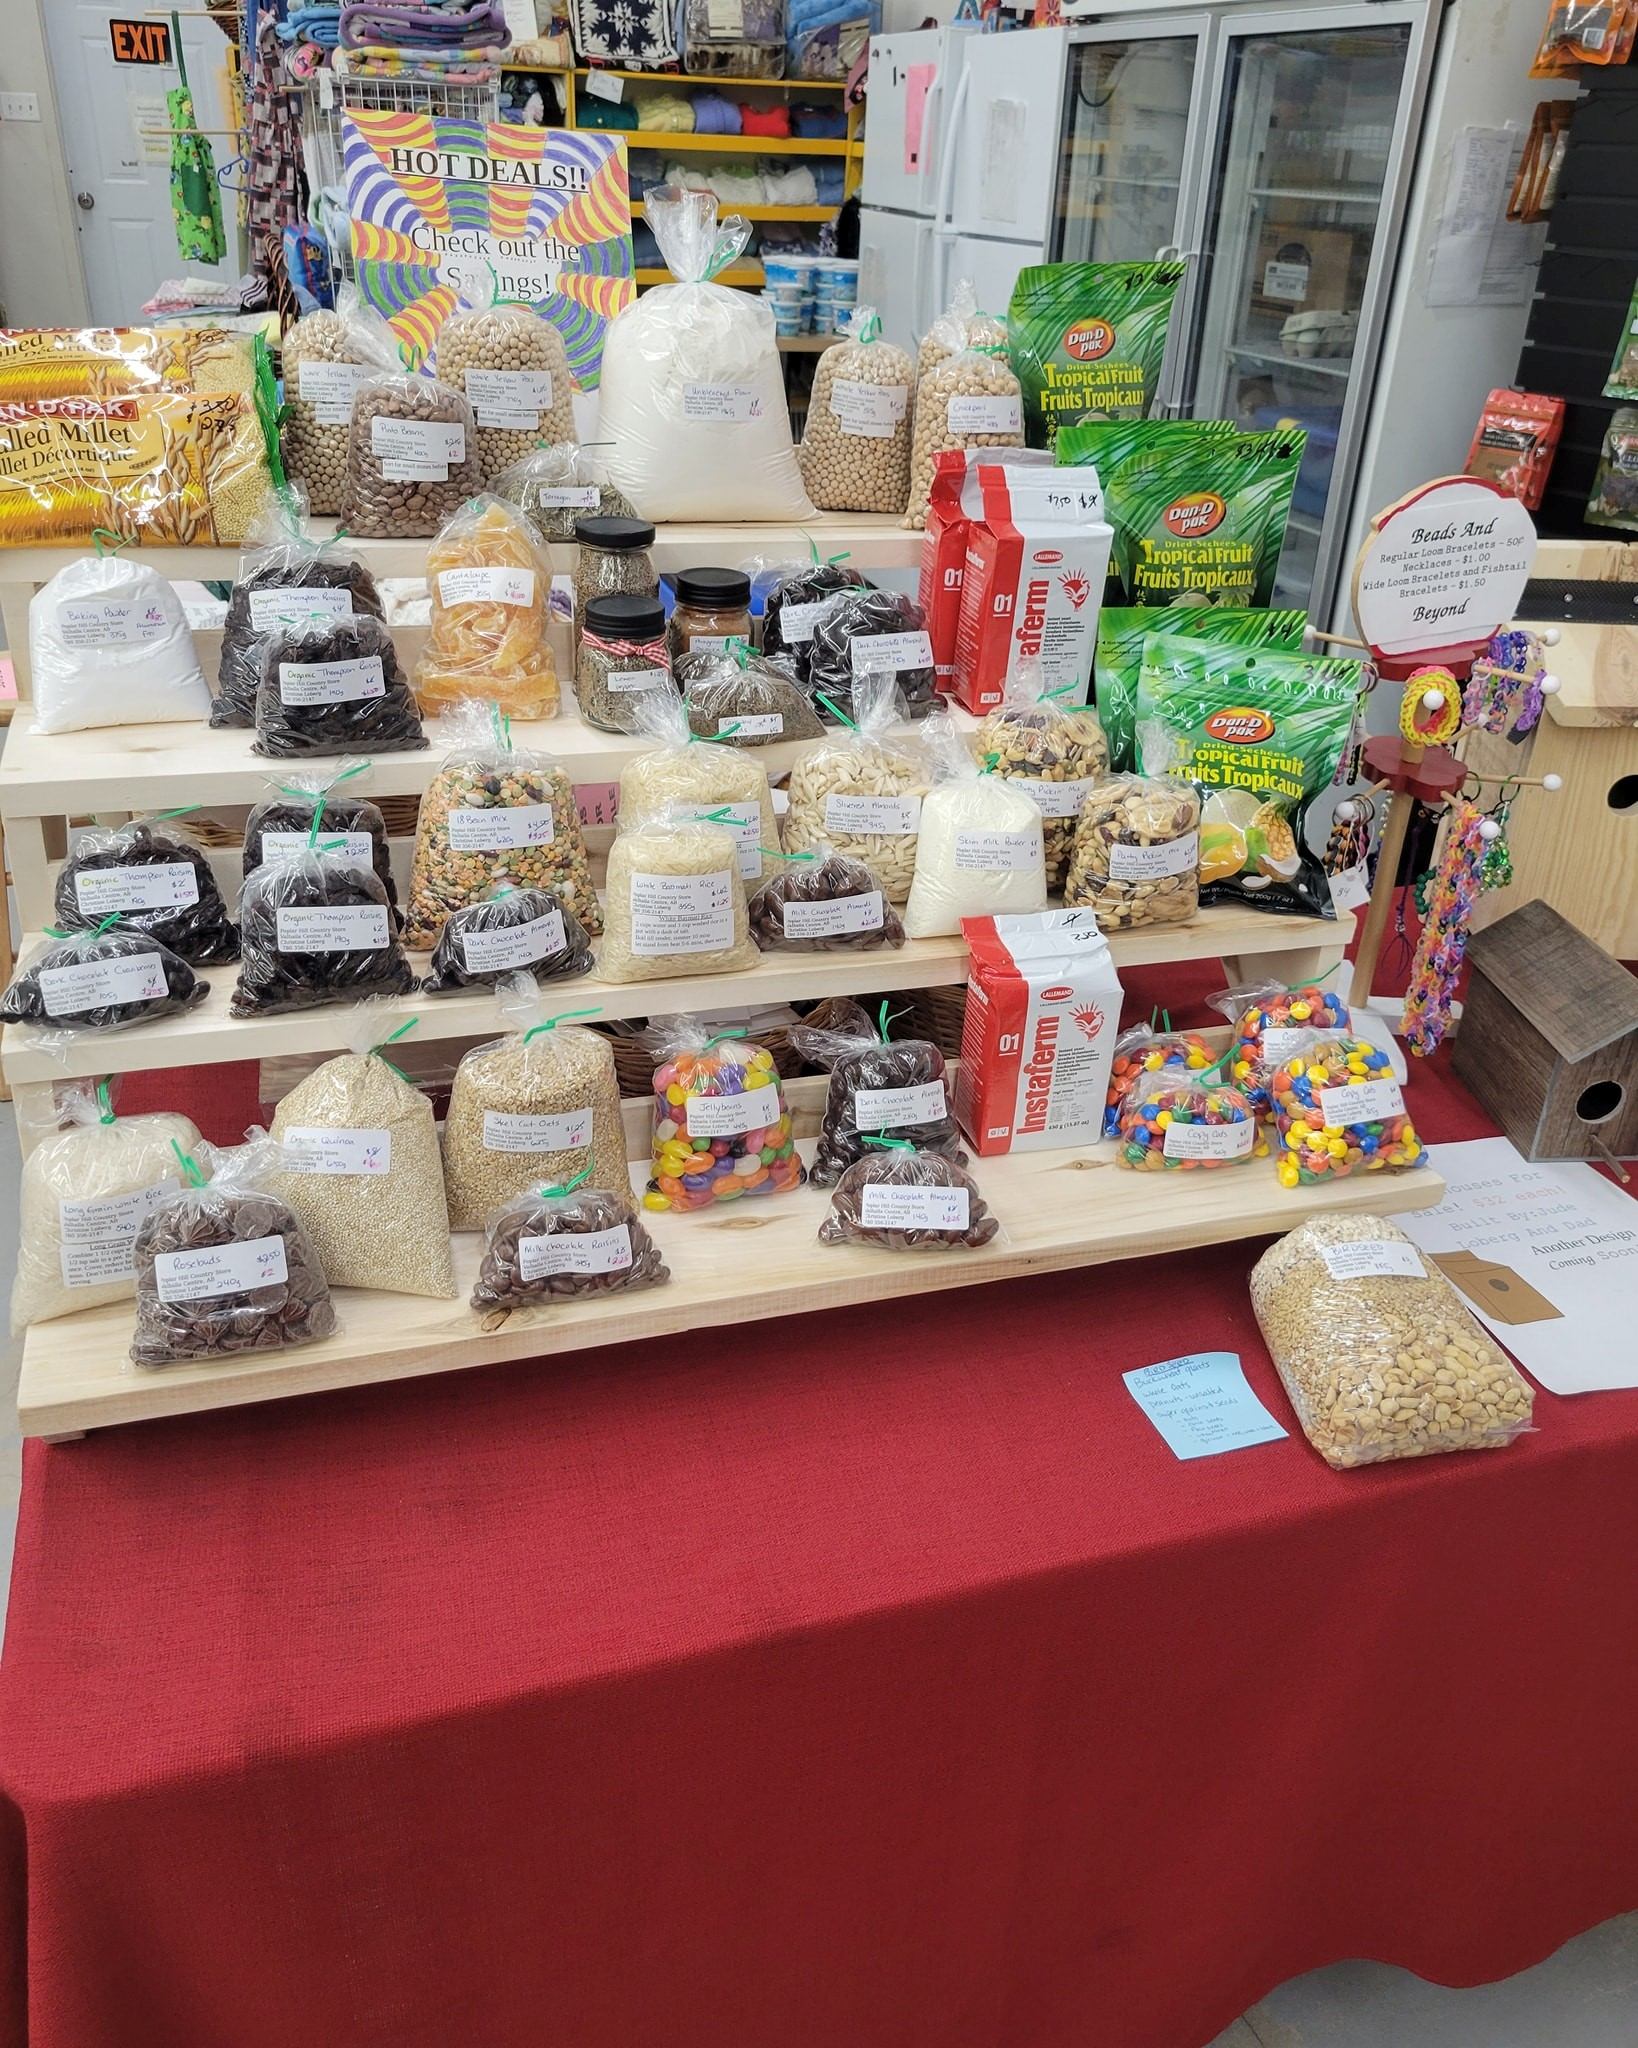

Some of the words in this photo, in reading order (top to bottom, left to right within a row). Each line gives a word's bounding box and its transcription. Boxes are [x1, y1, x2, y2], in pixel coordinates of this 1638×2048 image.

[113, 23, 167, 61] EXIT
[391, 148, 461, 177] HOT
[467, 156, 588, 190] DEALS!!
[411, 226, 490, 254] Check
[500, 237, 536, 258] out
[543, 238, 580, 262] the
[447, 267, 550, 299] Sangs!
[1080, 340, 1103, 356] pak
[1043, 363, 1110, 388] Tropical
[1112, 366, 1143, 384] Fruit
[1040, 390, 1082, 411] Fruits
[59, 421, 132, 445] Millet
[1182, 516, 1208, 533] pak
[1411, 522, 1457, 545] Beads
[1460, 517, 1498, 537] And
[1141, 539, 1212, 564] Tropical
[1215, 543, 1253, 563] Fruit
[1380, 551, 1419, 564] Regular
[1421, 547, 1444, 557] Loom
[1446, 541, 1496, 555] Bracelets
[1402, 559, 1452, 573] Necklaces
[1462, 553, 1490, 565] $1.00
[1134, 563, 1180, 588] Fruits
[1182, 565, 1253, 592] Tropicaux
[1363, 580, 1385, 592] Wide
[1387, 576, 1409, 587] Loom
[1411, 570, 1460, 584] Bracelets
[1462, 567, 1479, 576] and
[1481, 561, 1527, 575] Fishtail
[1399, 585, 1448, 598] Bracelets
[1459, 577, 1486, 591] $1.50
[993, 594, 1012, 612] 01
[1412, 598, 1470, 624] Beyond
[66, 611, 100, 625] Baking
[1016, 580, 1050, 656] aferm
[1228, 726, 1256, 737] pak
[1177, 740, 1260, 769] Topical
[1262, 755, 1305, 776] Fruit
[1224, 765, 1305, 798] Tropicaux
[491, 814, 507, 823] Mix
[82, 876, 119, 889] Organic
[120, 872, 164, 882] Thompson
[168, 866, 193, 877] Raisins
[699, 880, 715, 888] Rice
[283, 913, 313, 926] Organic
[315, 912, 354, 924] Thompson
[468, 937, 486, 946] Dark
[490, 930, 527, 944] Chocolate
[1000, 1034, 1019, 1051] 01
[1017, 1015, 1060, 1136] Instaferm
[700, 1102, 742, 1114] Jellybeans
[539, 1119, 560, 1127] Oats
[321, 1135, 355, 1145] Quinoa
[1508, 1171, 1544, 1184] For
[145, 1189, 163, 1200] Rice
[891, 1191, 925, 1201] Chocolate
[1412, 1202, 1464, 1219] Sale!
[1472, 1195, 1509, 1208] $32
[1515, 1186, 1568, 1201] each!
[1449, 1216, 1501, 1233] Built
[1455, 1231, 1521, 1251] Loberg
[1526, 1225, 1557, 1238] And
[1561, 1216, 1597, 1231] Dad
[524, 1244, 543, 1254] Milk
[546, 1240, 585, 1252] Chocolate
[1531, 1238, 1586, 1257] Another
[1585, 1228, 1637, 1245] Design
[172, 1256, 222, 1271] Rosebuds
[1549, 1254, 1597, 1271] Coming
[216, 1278, 241, 1289] 240g
